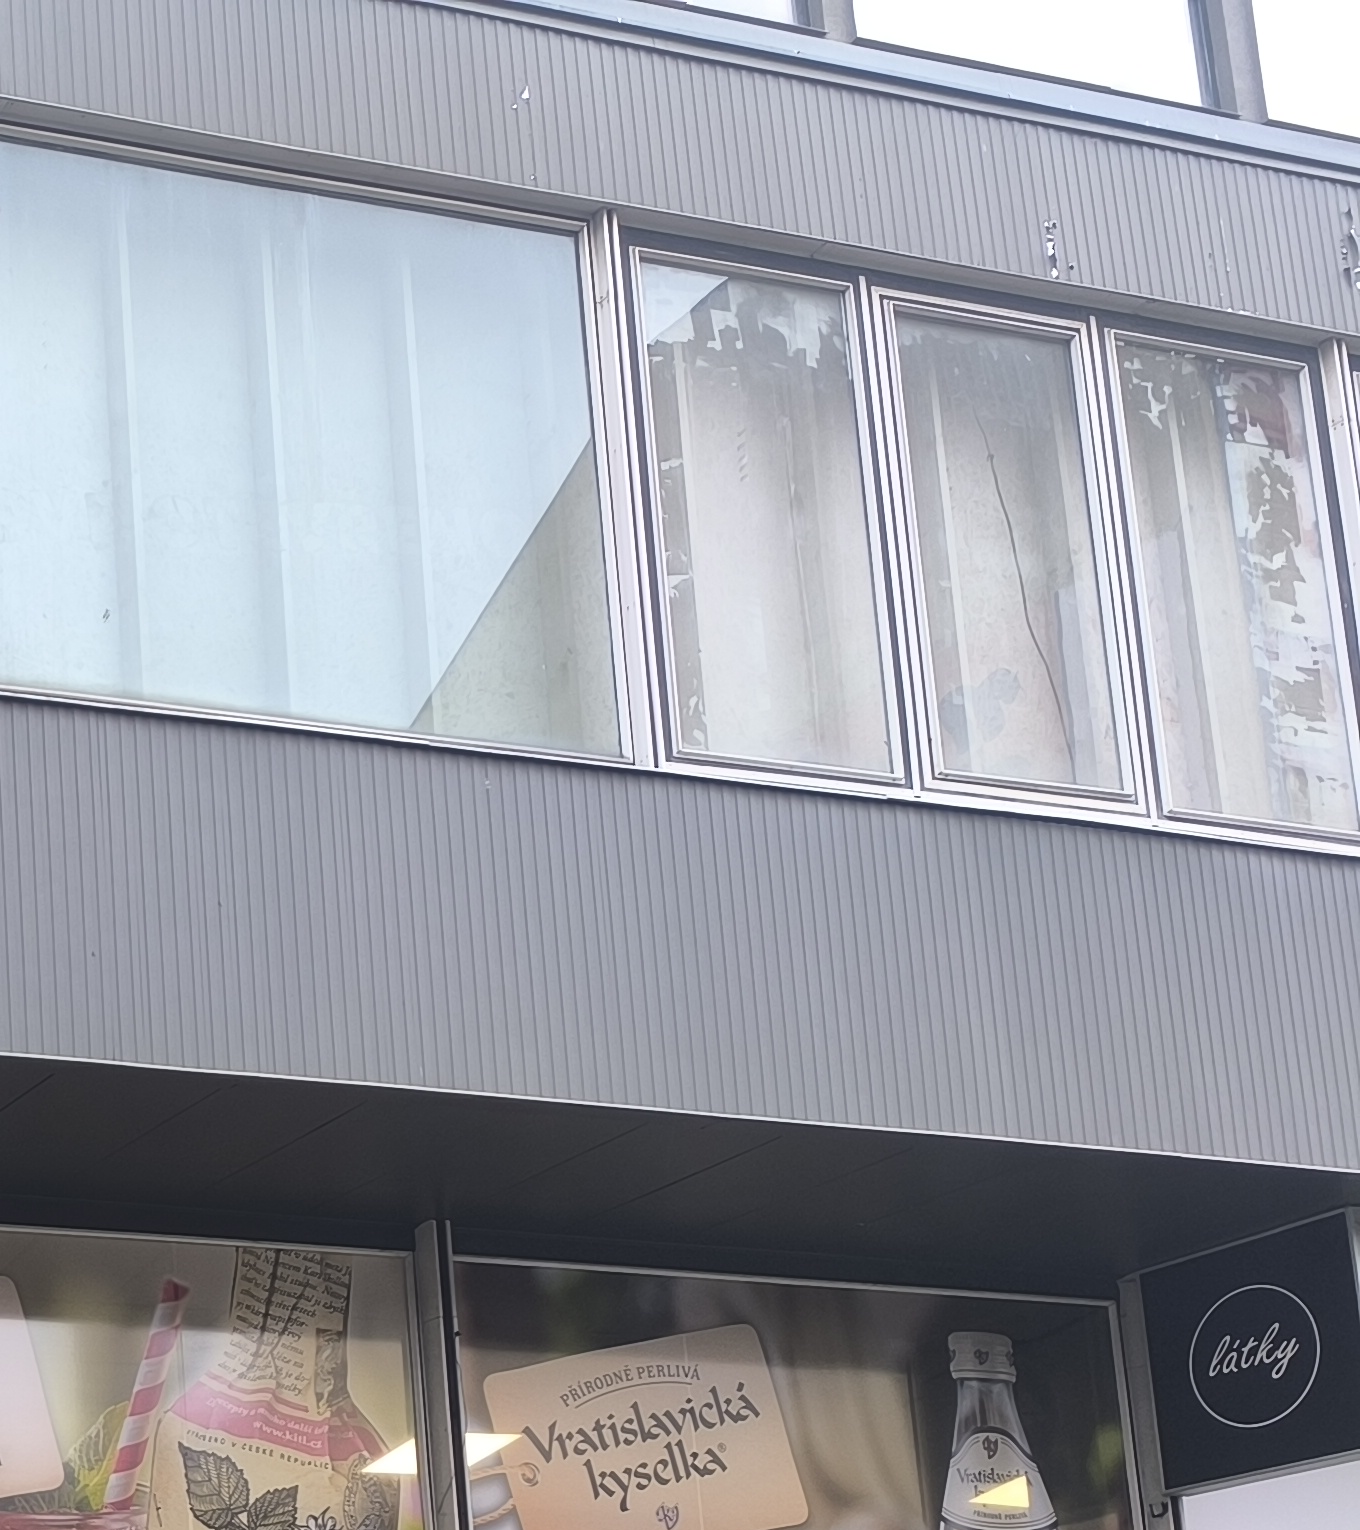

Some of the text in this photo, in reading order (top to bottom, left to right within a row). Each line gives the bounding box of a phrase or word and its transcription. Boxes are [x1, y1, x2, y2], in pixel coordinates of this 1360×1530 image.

[1208, 1321, 1300, 1380] látky
[559, 1363, 701, 1408] PŘÍRODNĚ PERLIVÁ
[521, 1381, 761, 1464] Vratislavická
[583, 1439, 728, 1513] kyselka
